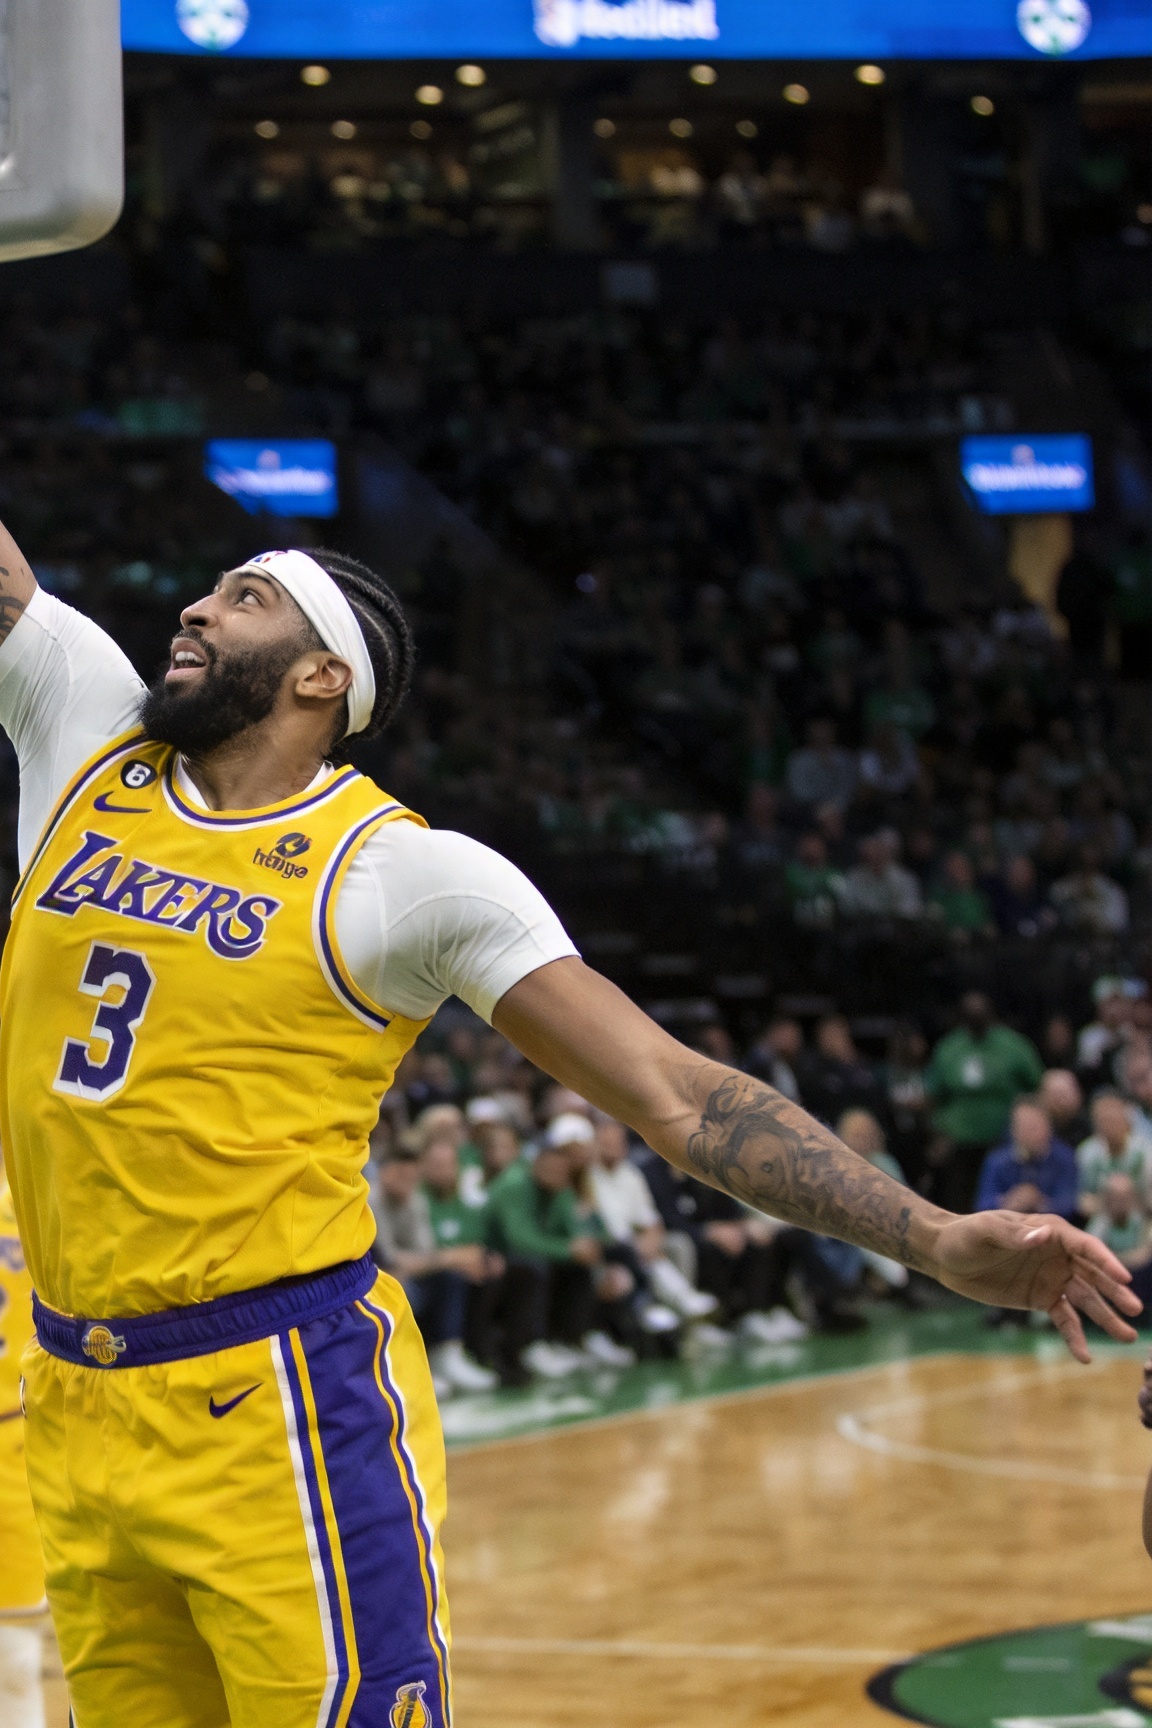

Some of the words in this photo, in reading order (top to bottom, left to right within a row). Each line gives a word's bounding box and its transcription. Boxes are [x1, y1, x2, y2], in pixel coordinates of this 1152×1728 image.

[125, 763, 152, 787] 6
[34, 829, 285, 961] LAKERS
[51, 939, 158, 1103] 3
